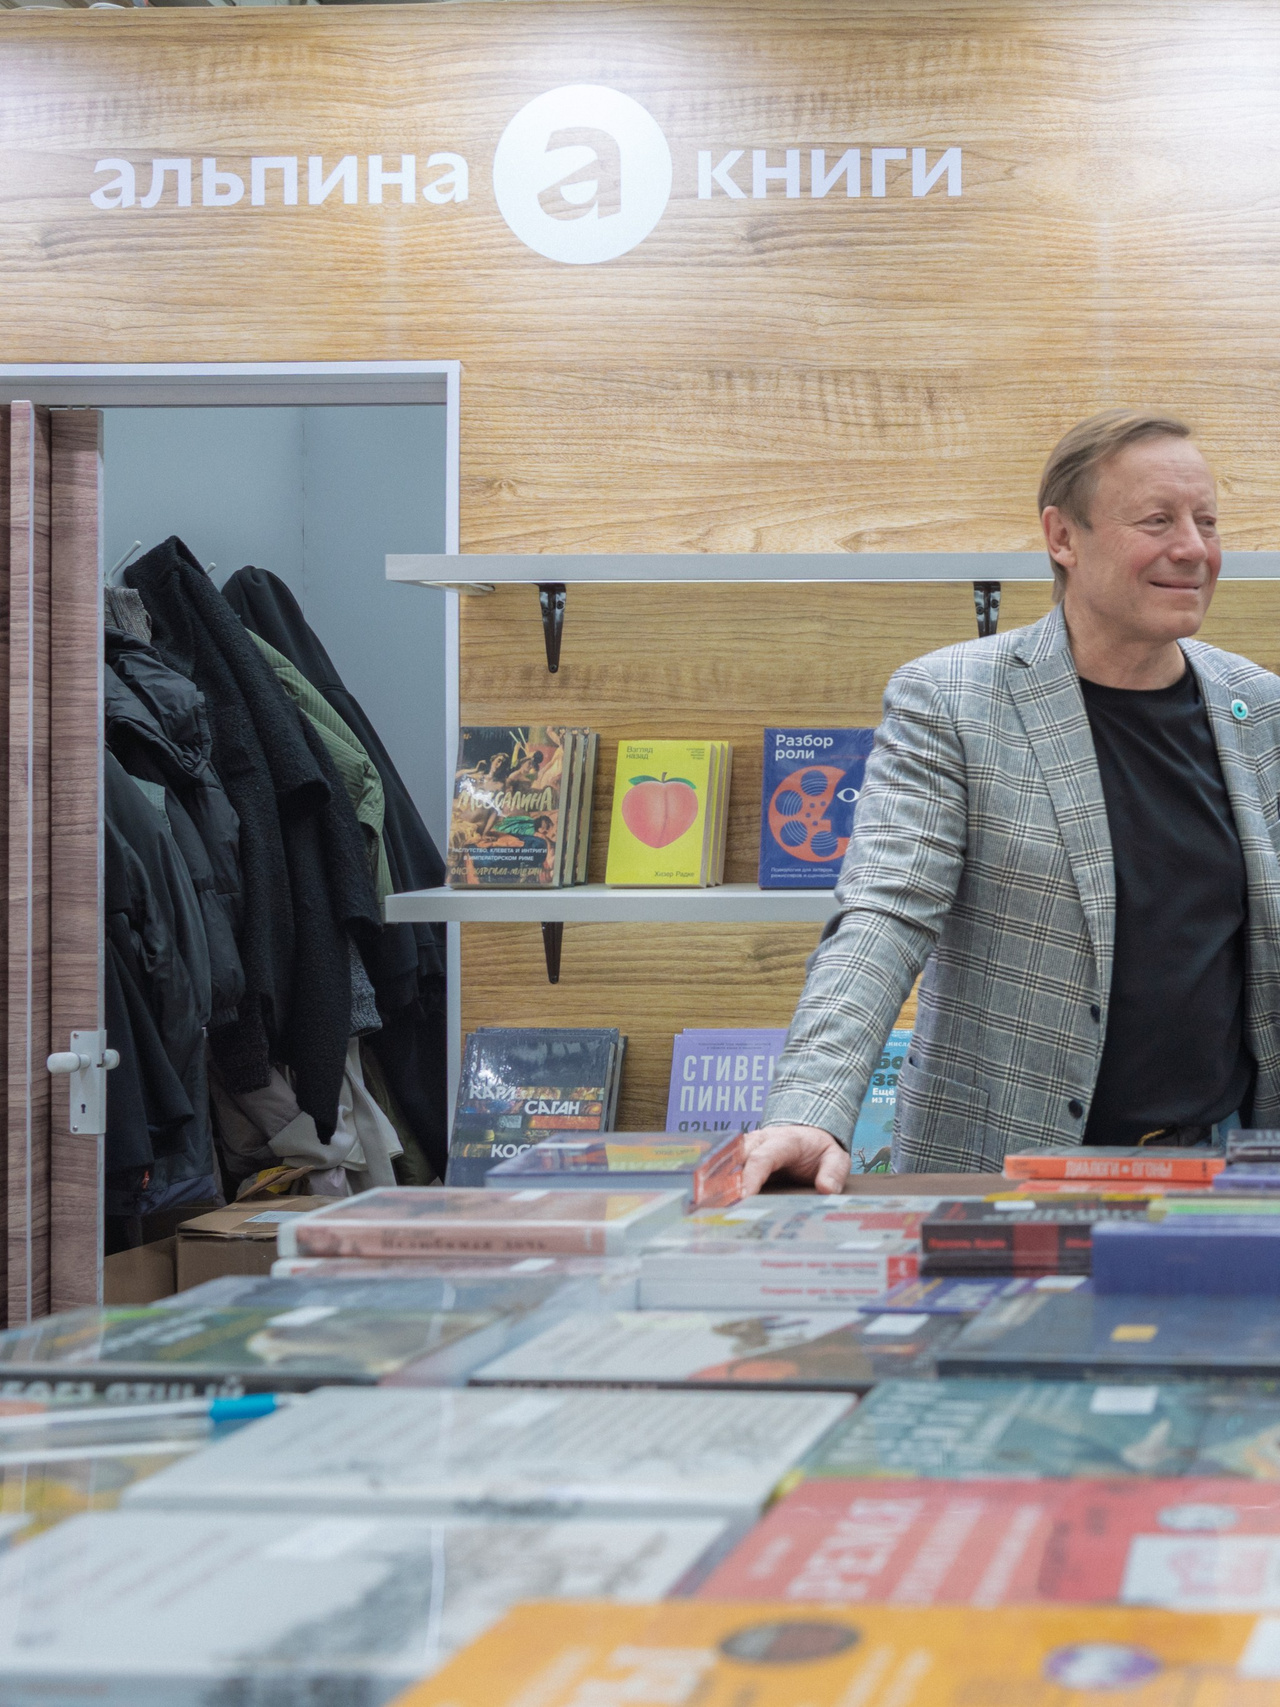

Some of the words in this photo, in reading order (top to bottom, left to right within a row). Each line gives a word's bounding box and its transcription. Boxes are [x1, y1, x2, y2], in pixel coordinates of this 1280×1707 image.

[90, 151, 470, 210] альпина
[697, 147, 963, 199] книги
[775, 734, 834, 749] Разбор
[626, 746, 654, 754] Взгляд
[774, 749, 815, 762] роли
[654, 870, 674, 878] Хизер
[675, 870, 695, 878] Радке
[680, 1085, 768, 1112] ПИНКЕ
[524, 1100, 580, 1115] САГАН
